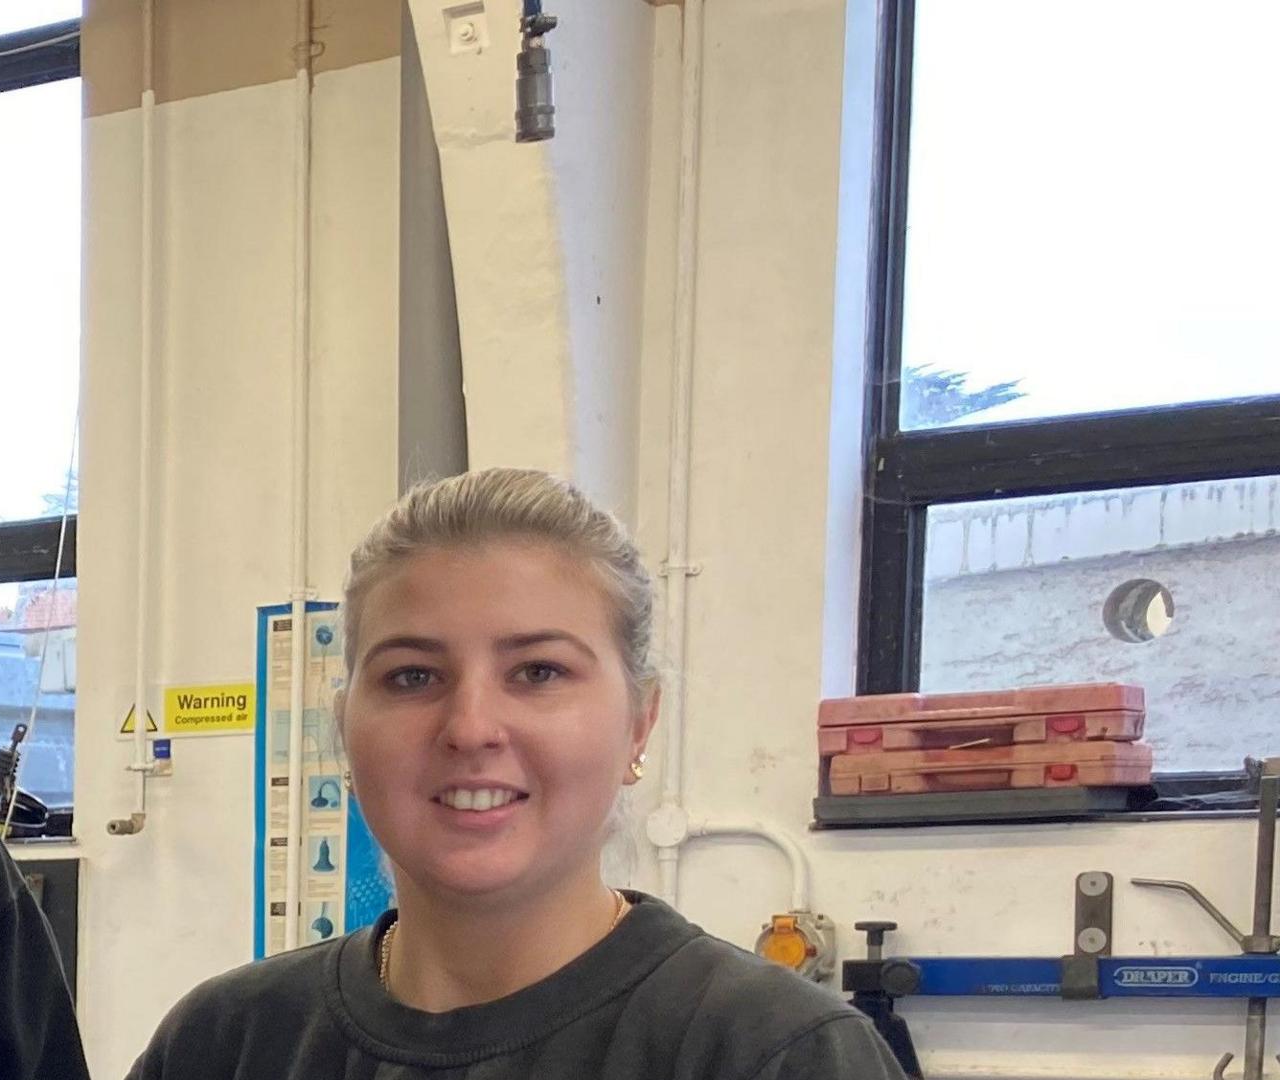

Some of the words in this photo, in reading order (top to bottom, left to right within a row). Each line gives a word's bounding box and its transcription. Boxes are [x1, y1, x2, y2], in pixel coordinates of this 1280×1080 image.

[177, 692, 248, 712] Warning
[174, 714, 233, 726] Compressed
[235, 713, 248, 722] air
[1121, 970, 1190, 983] DRAPER
